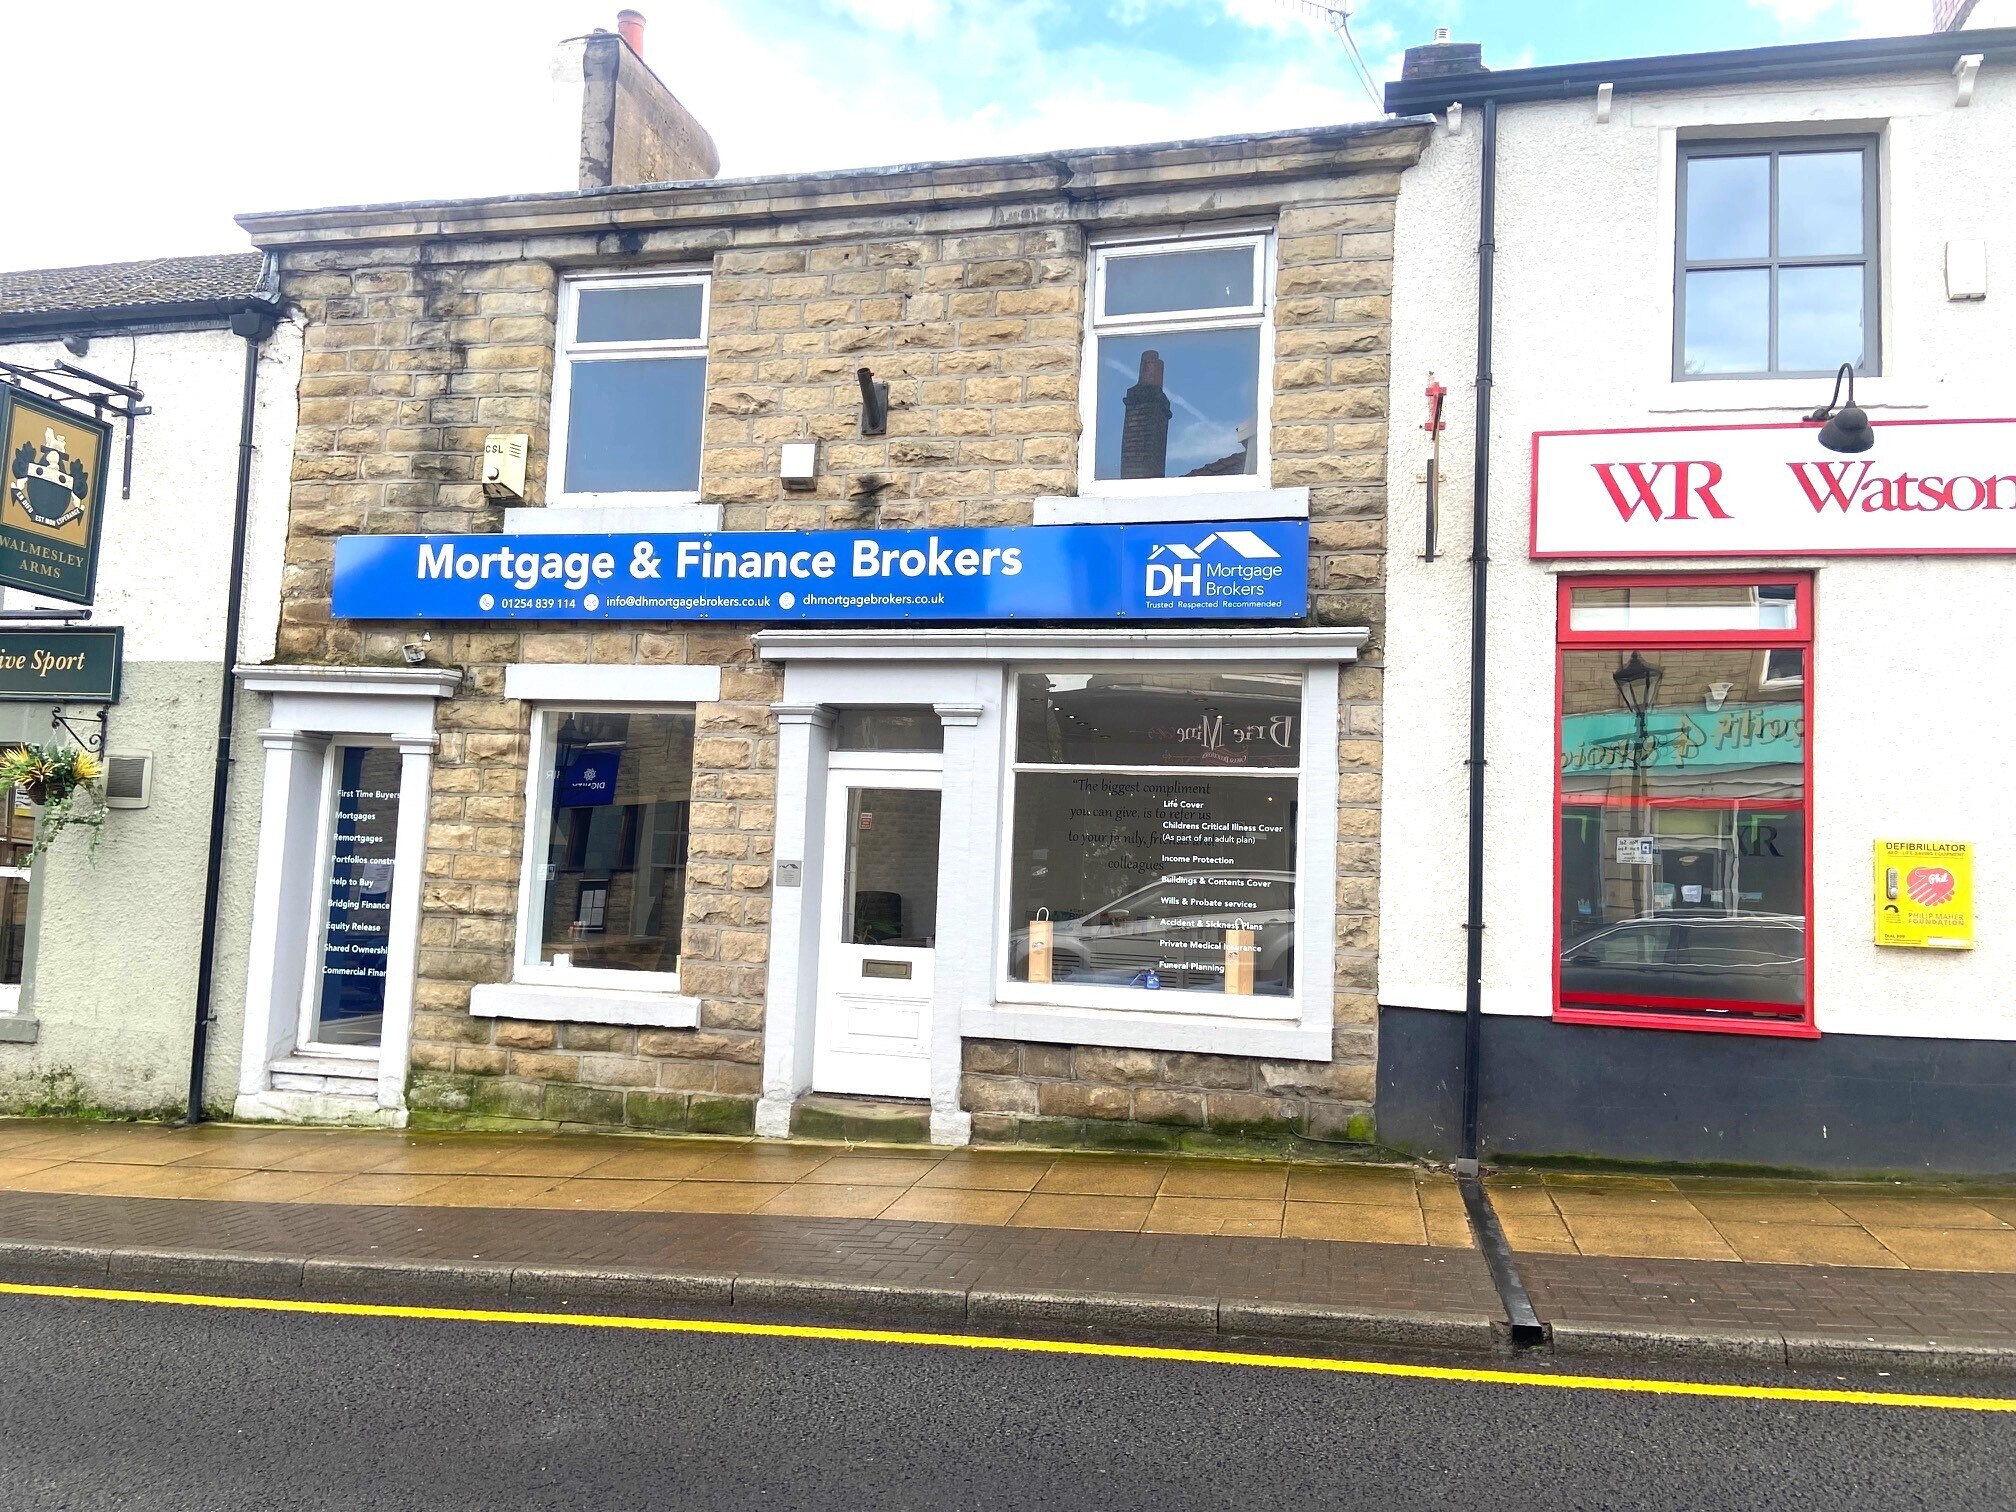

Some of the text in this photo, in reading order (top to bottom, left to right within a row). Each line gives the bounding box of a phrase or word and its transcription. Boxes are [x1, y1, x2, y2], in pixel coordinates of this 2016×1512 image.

[486, 444, 504, 454] CSL
[1591, 460, 2016, 523] WR Watson
[0, 534, 84, 568] WALMESLEY
[19, 559, 61, 579] ARMS
[417, 536, 1023, 590] Mortgage & Finance Brokers
[1206, 563, 1283, 581] Mortgage
[1145, 563, 1201, 597] DH
[1206, 580, 1264, 596] Brokers
[501, 598, 576, 609] 01254 839 114
[606, 595, 771, 610] info@dhmortgagebrokers.co.uk
[803, 592, 945, 608] dhmortgagebrokers.co.uk
[1146, 600, 1282, 609] Trusted Respected Recommended
[31, 650, 85, 677] Sport
[1101, 779, 1140, 796] biggest
[1143, 780, 1211, 797] compliment
[376, 790, 400, 800] Buyers
[335, 812, 376, 822] Mortgages
[1070, 806, 1212, 824] you can give, is to refer us
[1162, 821, 1283, 832] Childrens Critical Illness Cover
[333, 833, 383, 844] Remortgages
[1068, 831, 1079, 842] to
[1081, 834, 1105, 846] your
[1162, 833, 1174, 842] (As
[1176, 834, 1192, 843] part
[1193, 834, 1202, 842] of
[1214, 834, 1234, 843] adult
[1236, 836, 1256, 845] plan)
[1886, 842, 1966, 852] DEFIBRILLATOR
[331, 855, 368, 864] Portfolios
[1108, 855, 1164, 875] colleagues
[1162, 854, 1234, 864] Income Protection
[330, 877, 347, 887] Help
[359, 878, 374, 888] Buy
[1161, 876, 1272, 888] Buildings & Contents Cover
[328, 899, 390, 910] Bridging Finance
[1160, 896, 1257, 908] Wills & Probate services
[326, 922, 381, 932] Equity Release
[1160, 918, 1263, 930] Accident & Sickness Plans
[1908, 918, 1964, 926] FOUNDATION
[324, 943, 350, 952] Shared
[1160, 940, 1262, 952] Private Medical Insurance
[322, 966, 366, 976] Commercial
[1159, 960, 1225, 974] Funeral Planning
